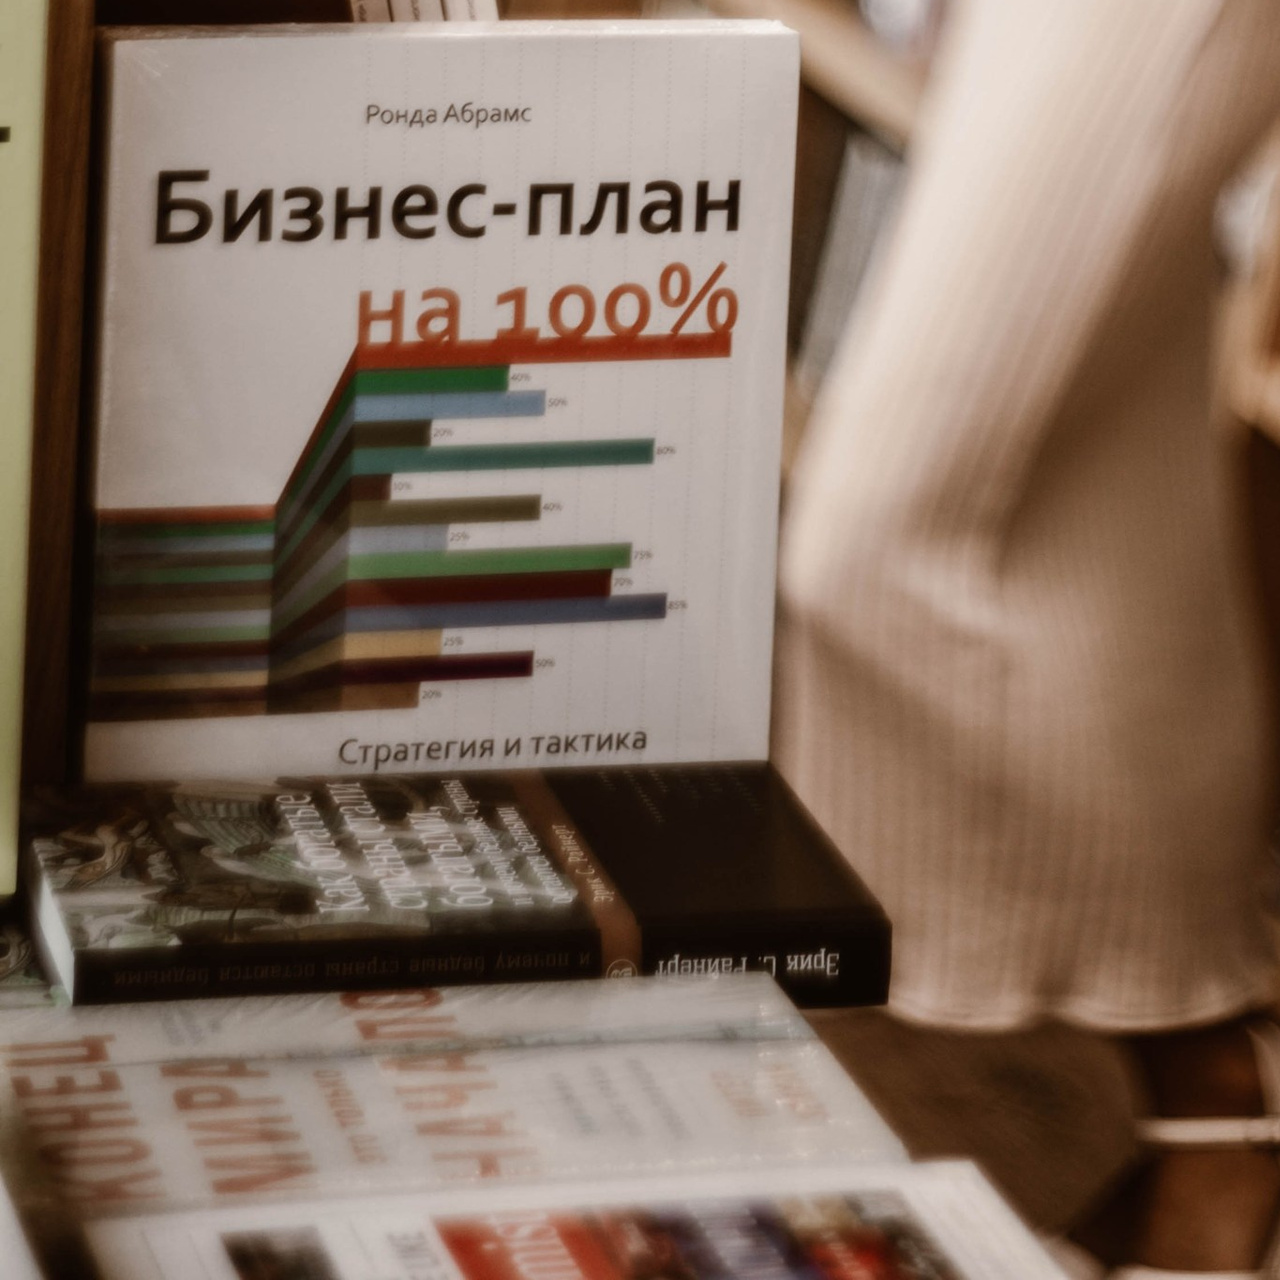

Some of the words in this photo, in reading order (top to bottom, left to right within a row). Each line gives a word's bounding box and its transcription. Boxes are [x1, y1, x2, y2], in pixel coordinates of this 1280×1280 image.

[366, 103, 438, 129] Ронда
[442, 101, 533, 128] Абрамс
[154, 169, 741, 244] Бизнес-план
[356, 286, 462, 346] на
[495, 261, 739, 342] 100%
[338, 734, 495, 770] Стратегия
[503, 738, 521, 757] и
[531, 726, 648, 756] тактика
[276, 794, 346, 871] богатые
[327, 782, 385, 834] стали
[316, 875, 369, 913] Как
[357, 837, 428, 909] страны
[786, 948, 840, 977] Эрик
[4, 1034, 168, 1201] КОНЕЦ
[339, 987, 542, 1179] НАЧАЛО
[160, 1058, 320, 1195] МИРА
